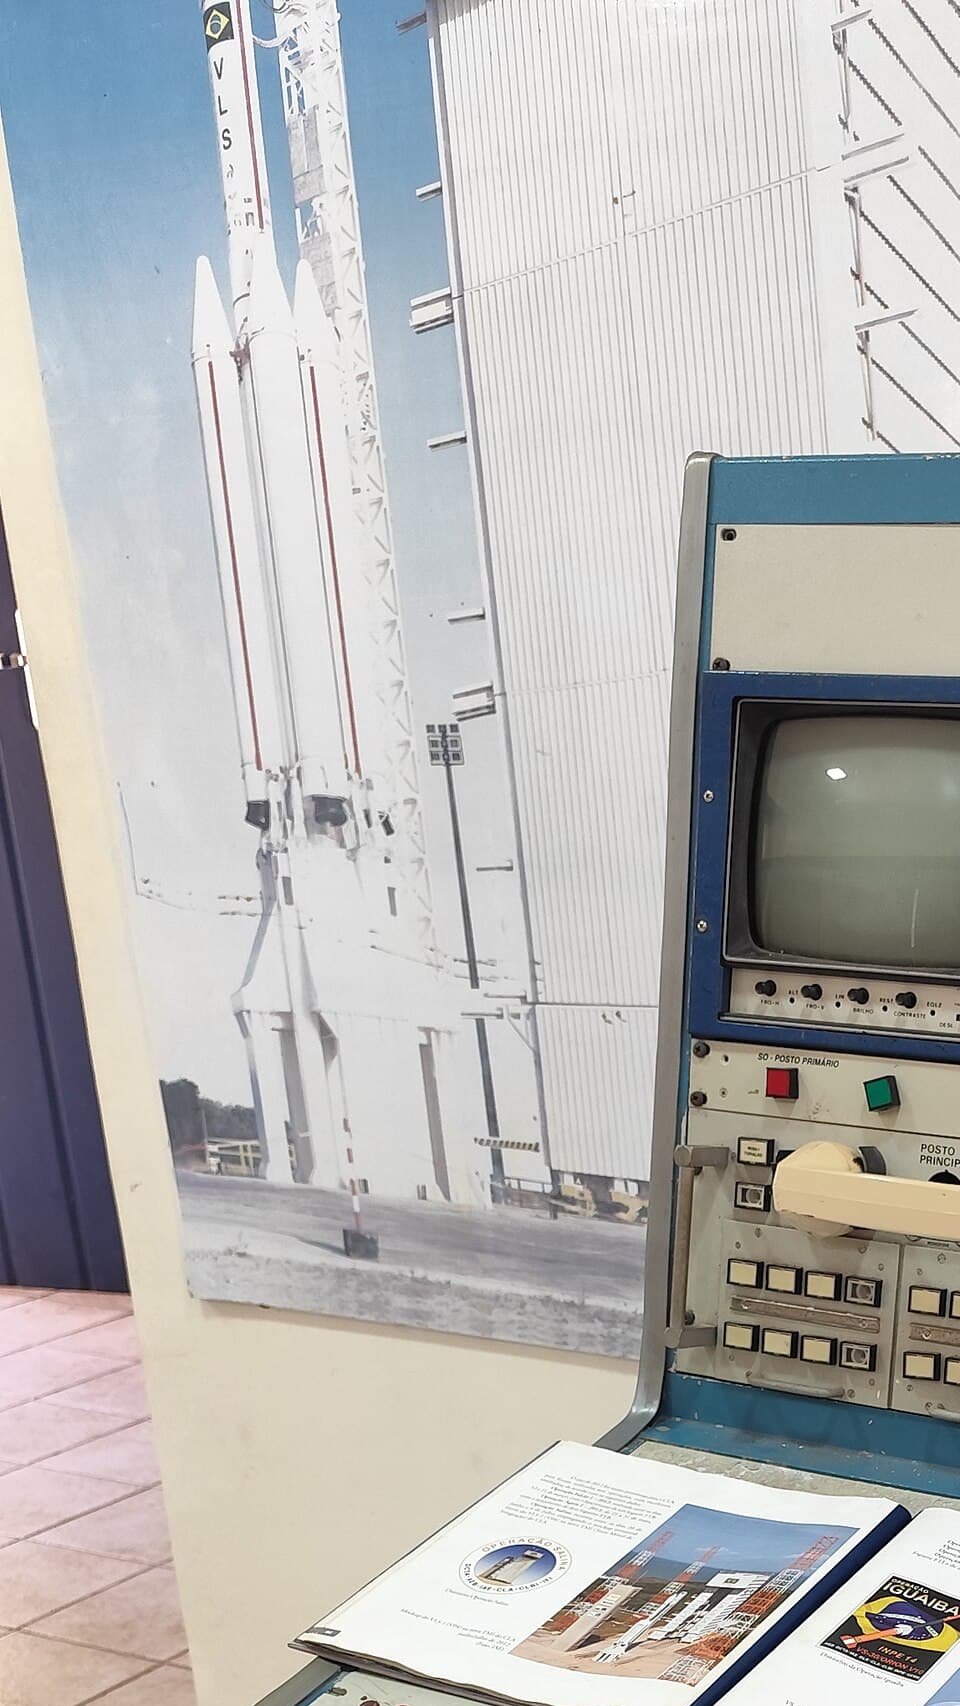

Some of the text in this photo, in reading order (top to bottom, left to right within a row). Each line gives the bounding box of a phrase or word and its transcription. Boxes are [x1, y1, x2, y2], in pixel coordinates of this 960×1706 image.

[213, 57, 233, 151] VLS
[894, 1011, 926, 1019] CONTRASTE
[757, 1052, 769, 1061] SO
[774, 1054, 801, 1064] POSTO
[802, 1057, 840, 1068] PRIMÁRIO
[920, 1143, 956, 1156] POSTO
[481, 1537, 553, 1554] OPERAÇÃO
[882, 1582, 960, 1616] IGUAIBA
[878, 1645, 918, 1664] INPE 14
